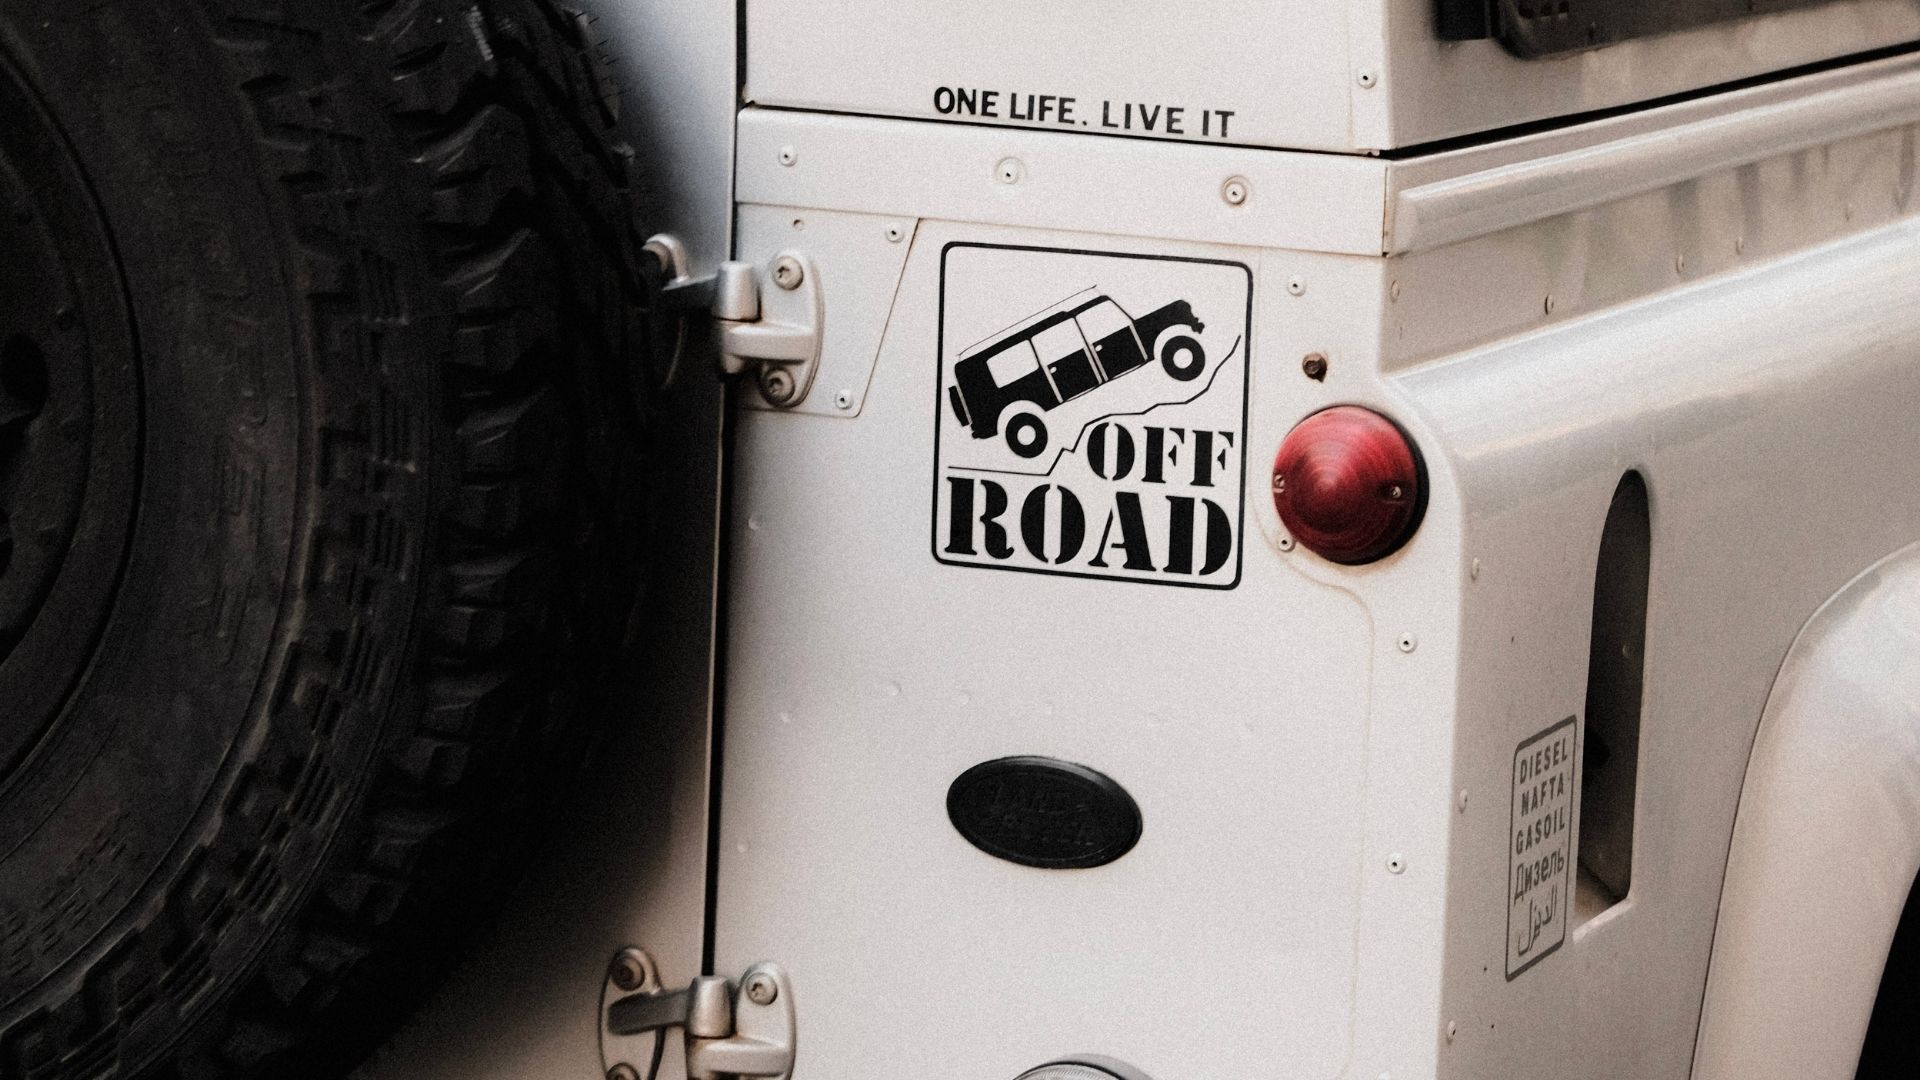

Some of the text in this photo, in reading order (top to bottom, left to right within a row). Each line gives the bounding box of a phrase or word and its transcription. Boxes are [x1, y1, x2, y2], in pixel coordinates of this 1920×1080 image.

[933, 86, 1235, 138] ONE LIFE. LIVE IT
[1086, 421, 1235, 488] OFF
[944, 475, 1233, 576] ROAD
[1519, 737, 1568, 785] DIESEL
[1521, 772, 1564, 817] NAFTA
[1516, 806, 1565, 855] GASOIL
[1513, 848, 1564, 906] Дизель
